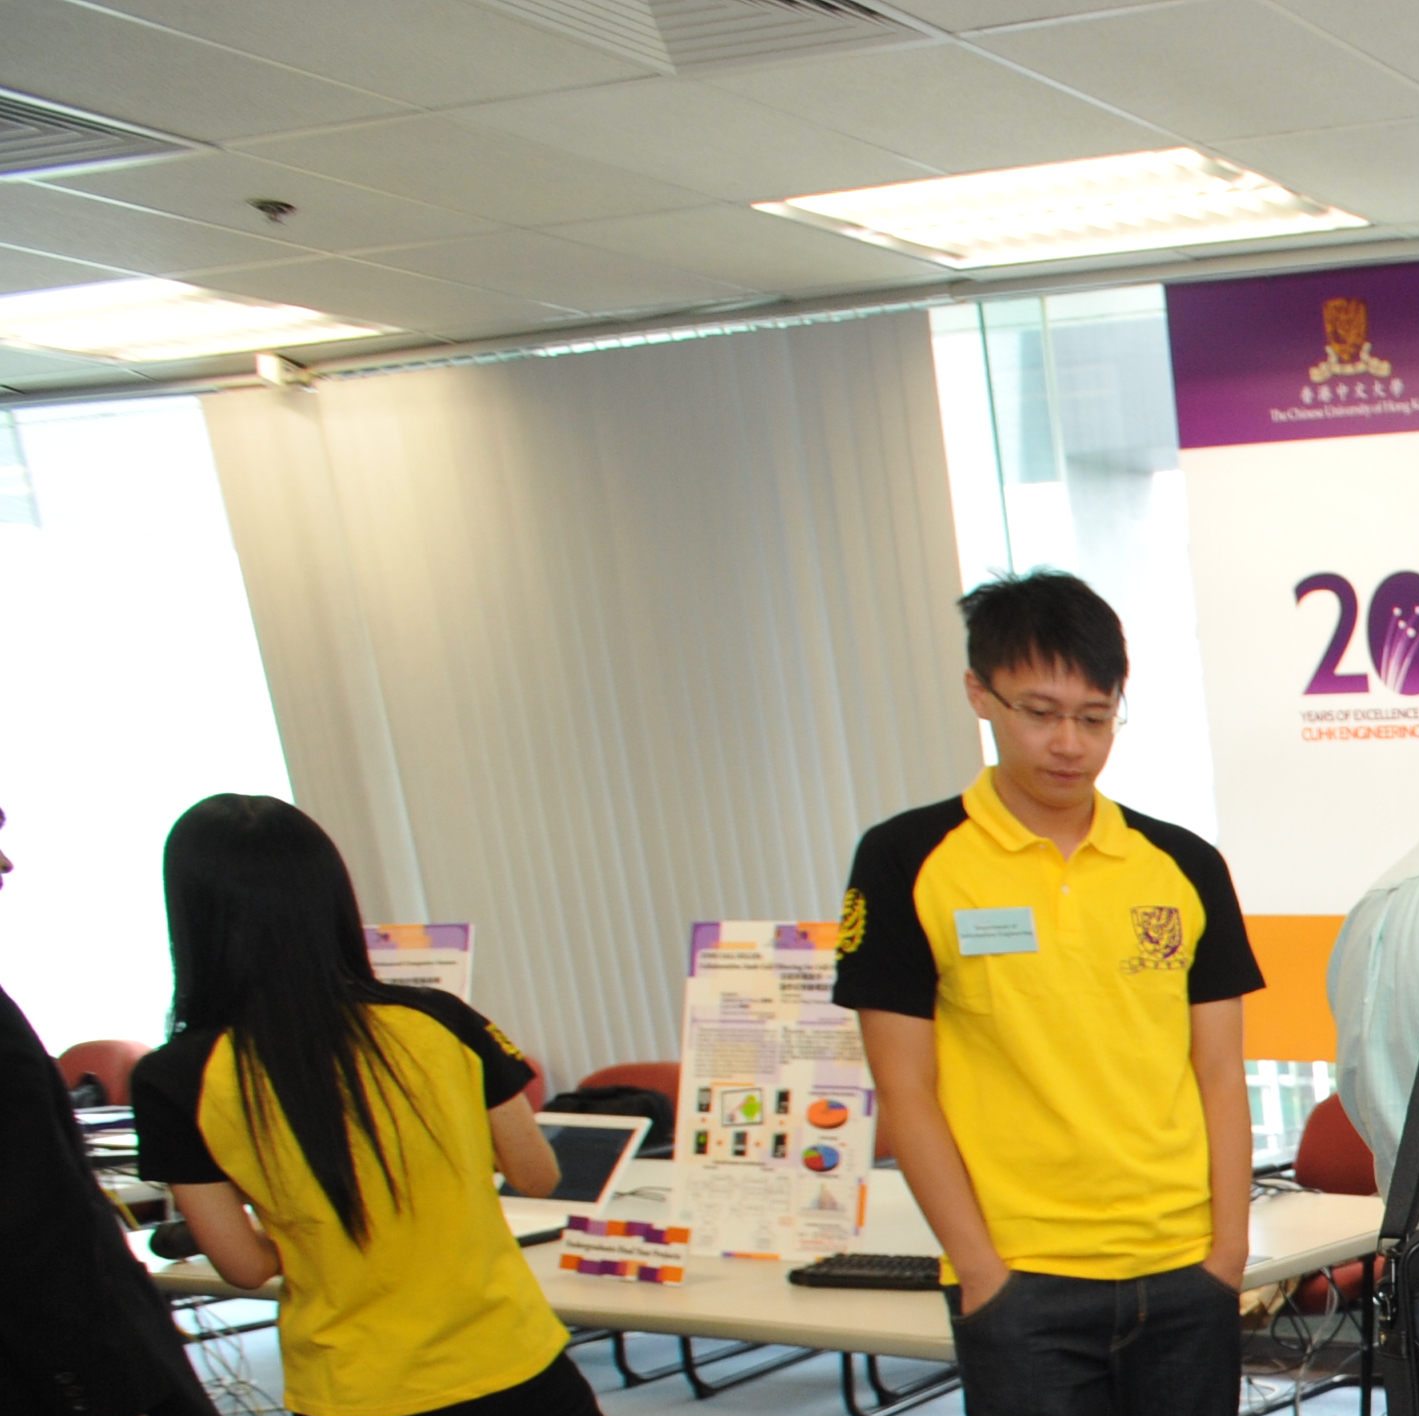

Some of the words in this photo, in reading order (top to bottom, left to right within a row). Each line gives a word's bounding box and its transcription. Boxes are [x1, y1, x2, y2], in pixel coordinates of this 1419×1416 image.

[1270, 408, 1287, 422] The
[1287, 406, 1324, 421] Chinese
[1324, 403, 1371, 419] University
[1383, 400, 1411, 415] Hong
[1301, 710, 1334, 722] YEARS
[1336, 710, 1350, 721] OF
[1353, 708, 1419, 721] EXCELLENCE
[1302, 726, 1338, 741] CUHK
